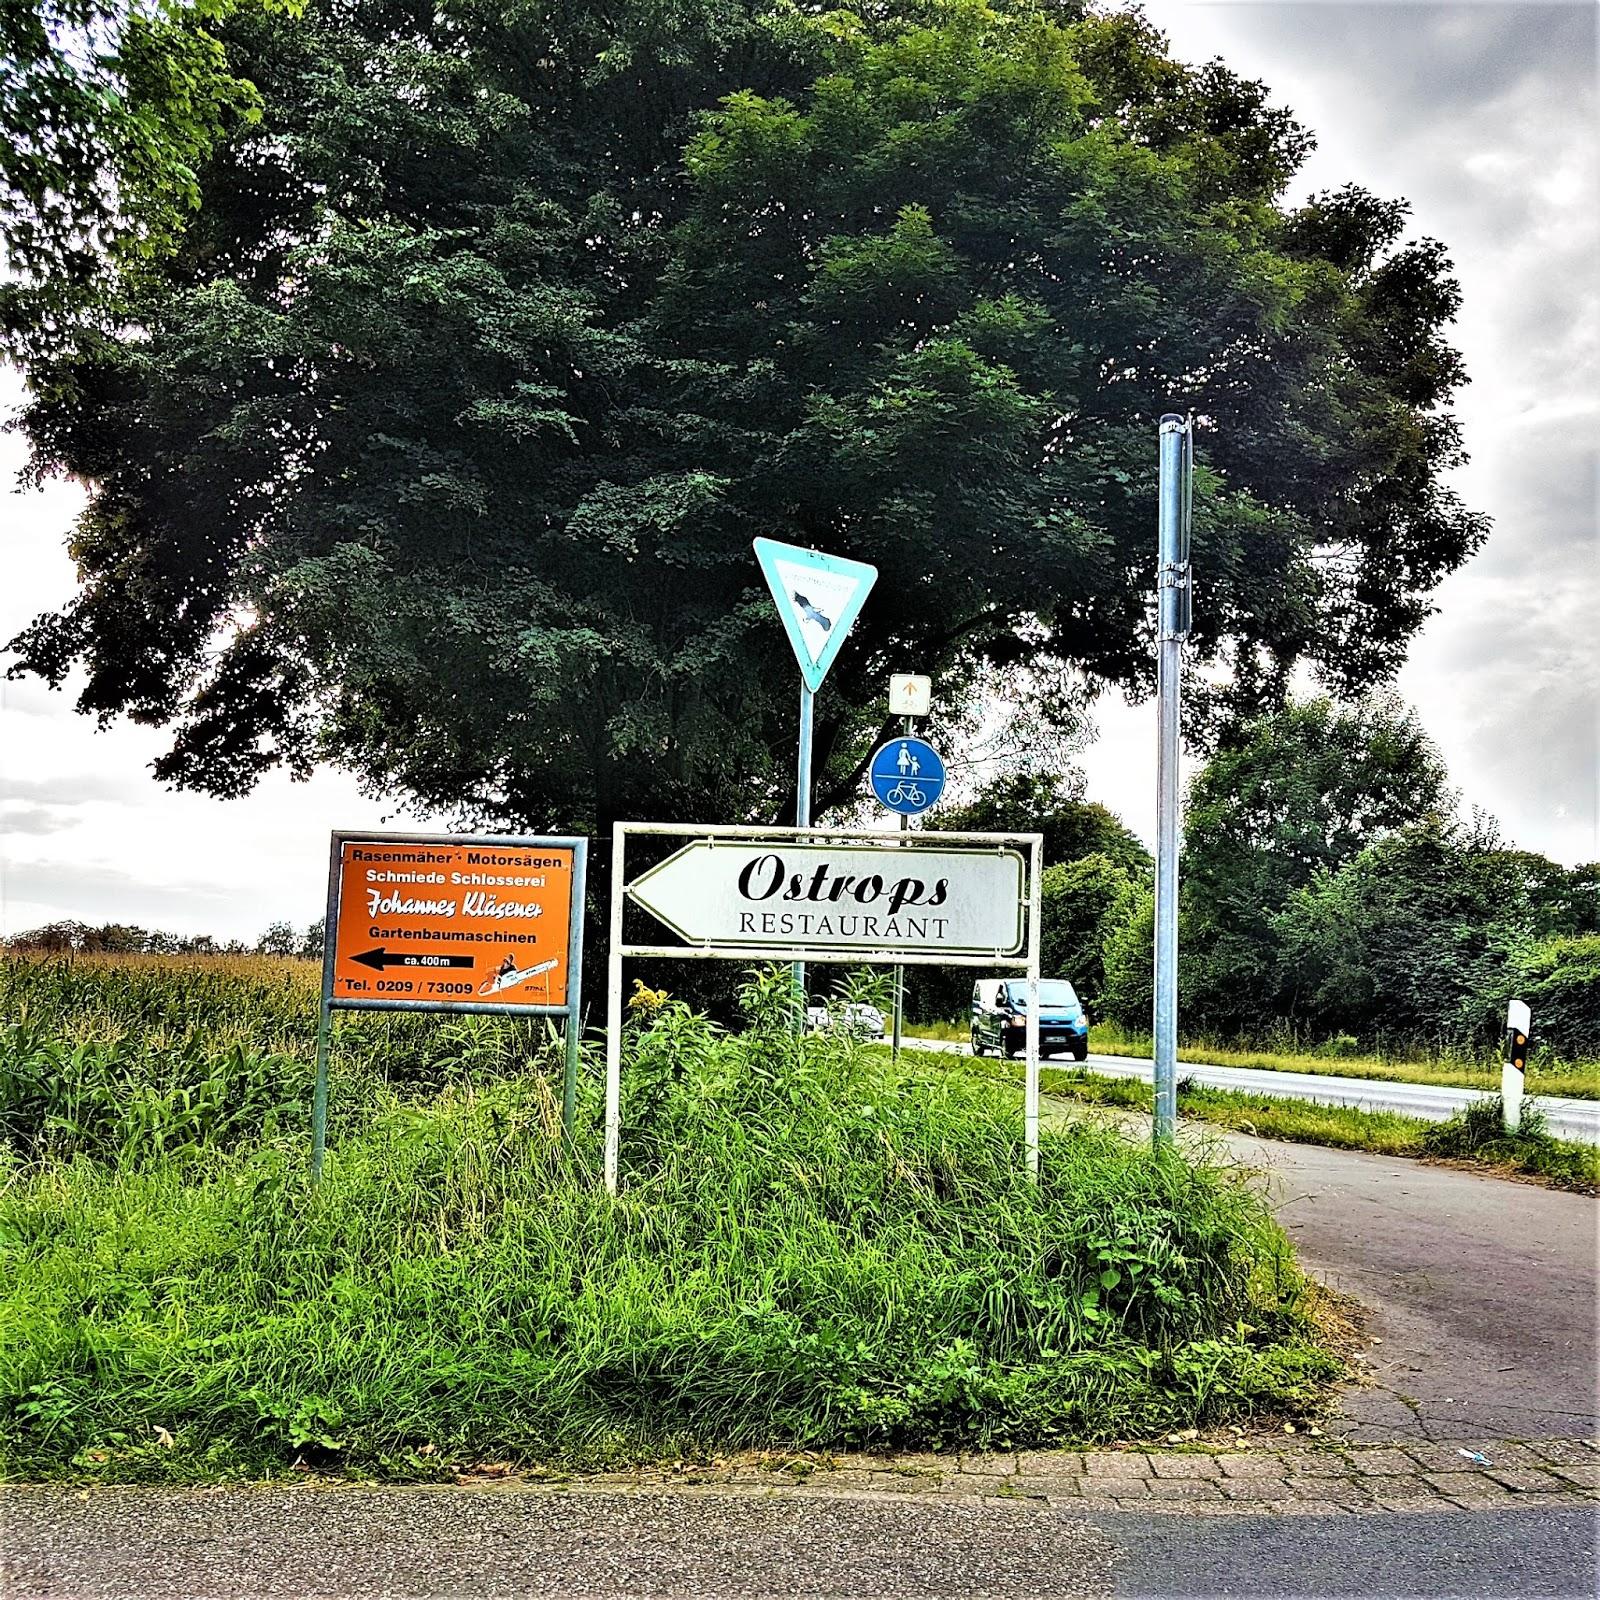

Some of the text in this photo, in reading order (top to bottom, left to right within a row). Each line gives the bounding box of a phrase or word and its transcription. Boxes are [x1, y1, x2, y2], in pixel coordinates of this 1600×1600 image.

[352, 849, 562, 868] Rasenmäher Motorsägen
[366, 869, 546, 888] Schmiede Schlosserei
[738, 853, 949, 916] Ostrops
[366, 888, 543, 920] Johannes Kläsener
[368, 926, 537, 944] Gartenbaumaschinen
[738, 912, 950, 940] RESTAURANT
[345, 978, 371, 992] Tel.
[376, 980, 414, 993] 0209
[427, 981, 473, 995] 73009
